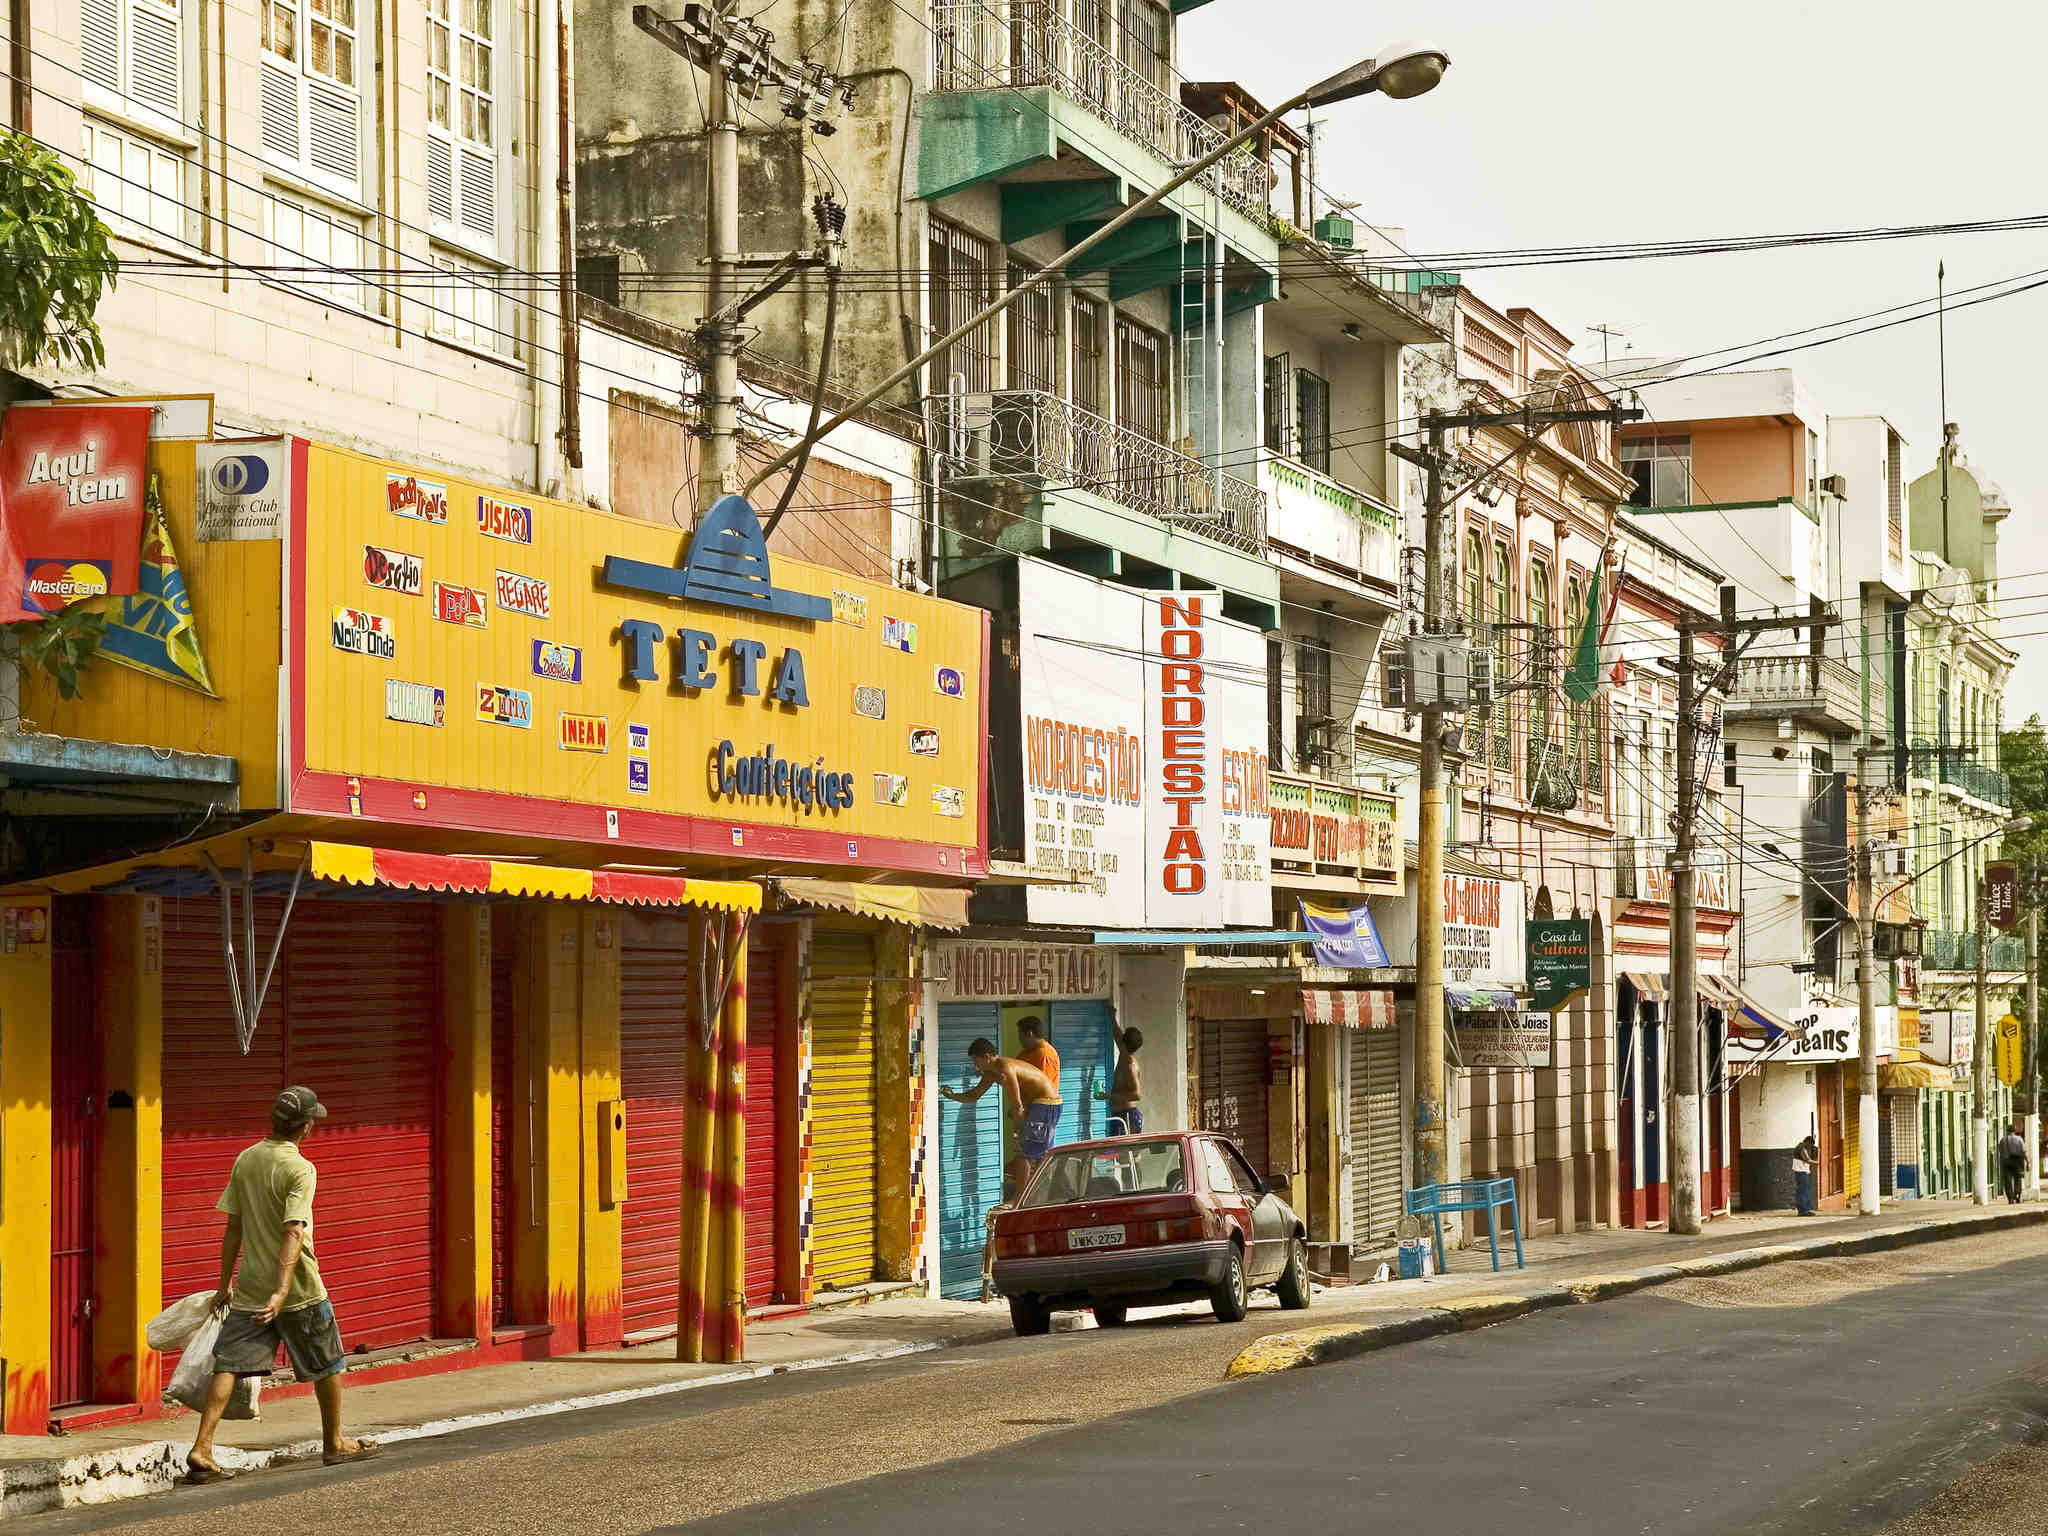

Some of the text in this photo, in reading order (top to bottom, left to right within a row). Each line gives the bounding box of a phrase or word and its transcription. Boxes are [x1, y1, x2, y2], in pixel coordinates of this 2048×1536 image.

[27, 441, 126, 506] Aqui tem
[200, 512, 279, 529] International
[206, 499, 278, 514] Diners Club
[28, 579, 106, 596] MasterCard
[496, 575, 549, 614] REGARE
[333, 620, 362, 650] Nova
[367, 630, 395, 658] Onda
[619, 618, 811, 708] TETA
[478, 686, 529, 721] Zurix
[632, 735, 646, 748] VISA
[1026, 713, 1142, 808] NORDESTÃO
[1160, 596, 1206, 896] NORDESTÃO
[1222, 746, 1269, 818] ESTÃO
[1313, 814, 1339, 863] TETA
[1988, 882, 2001, 921] Palace
[1531, 942, 1589, 956] Cultura
[1540, 929, 1581, 942] Casa da
[1792, 1028, 1850, 1055] Jeans
